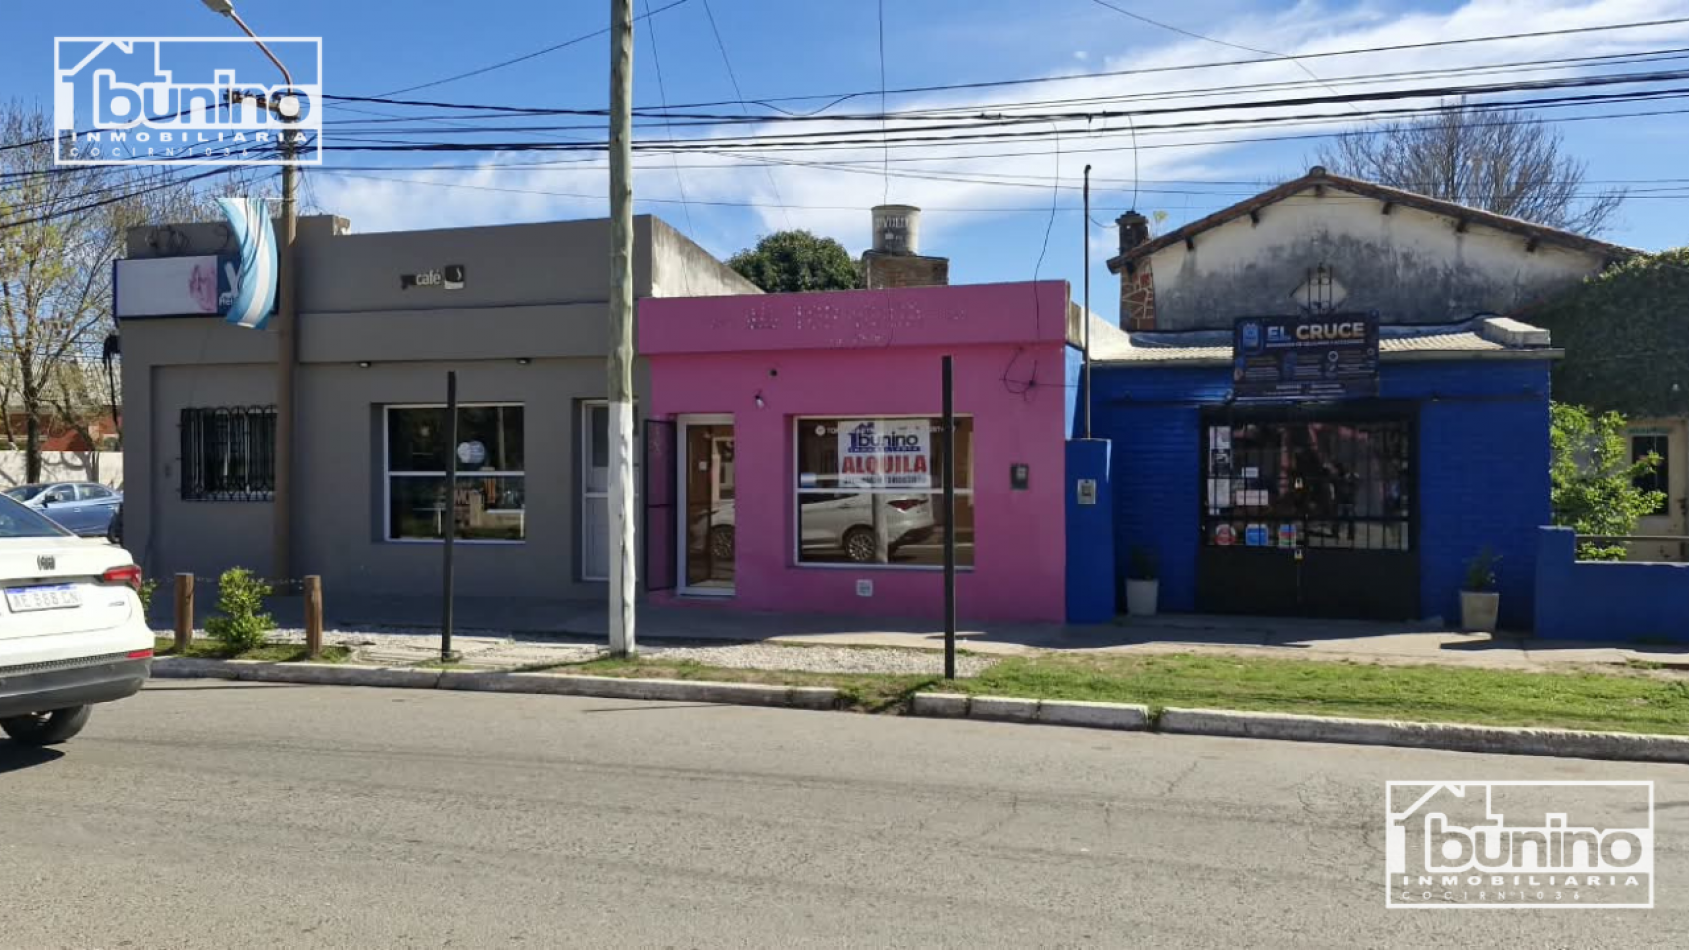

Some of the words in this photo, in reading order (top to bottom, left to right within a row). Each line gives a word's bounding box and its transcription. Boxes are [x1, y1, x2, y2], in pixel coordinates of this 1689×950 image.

[416, 267, 442, 286] café
[1266, 325, 1289, 341] EL
[1296, 321, 1366, 340] CRUCE
[842, 455, 927, 474] ALQUILA
